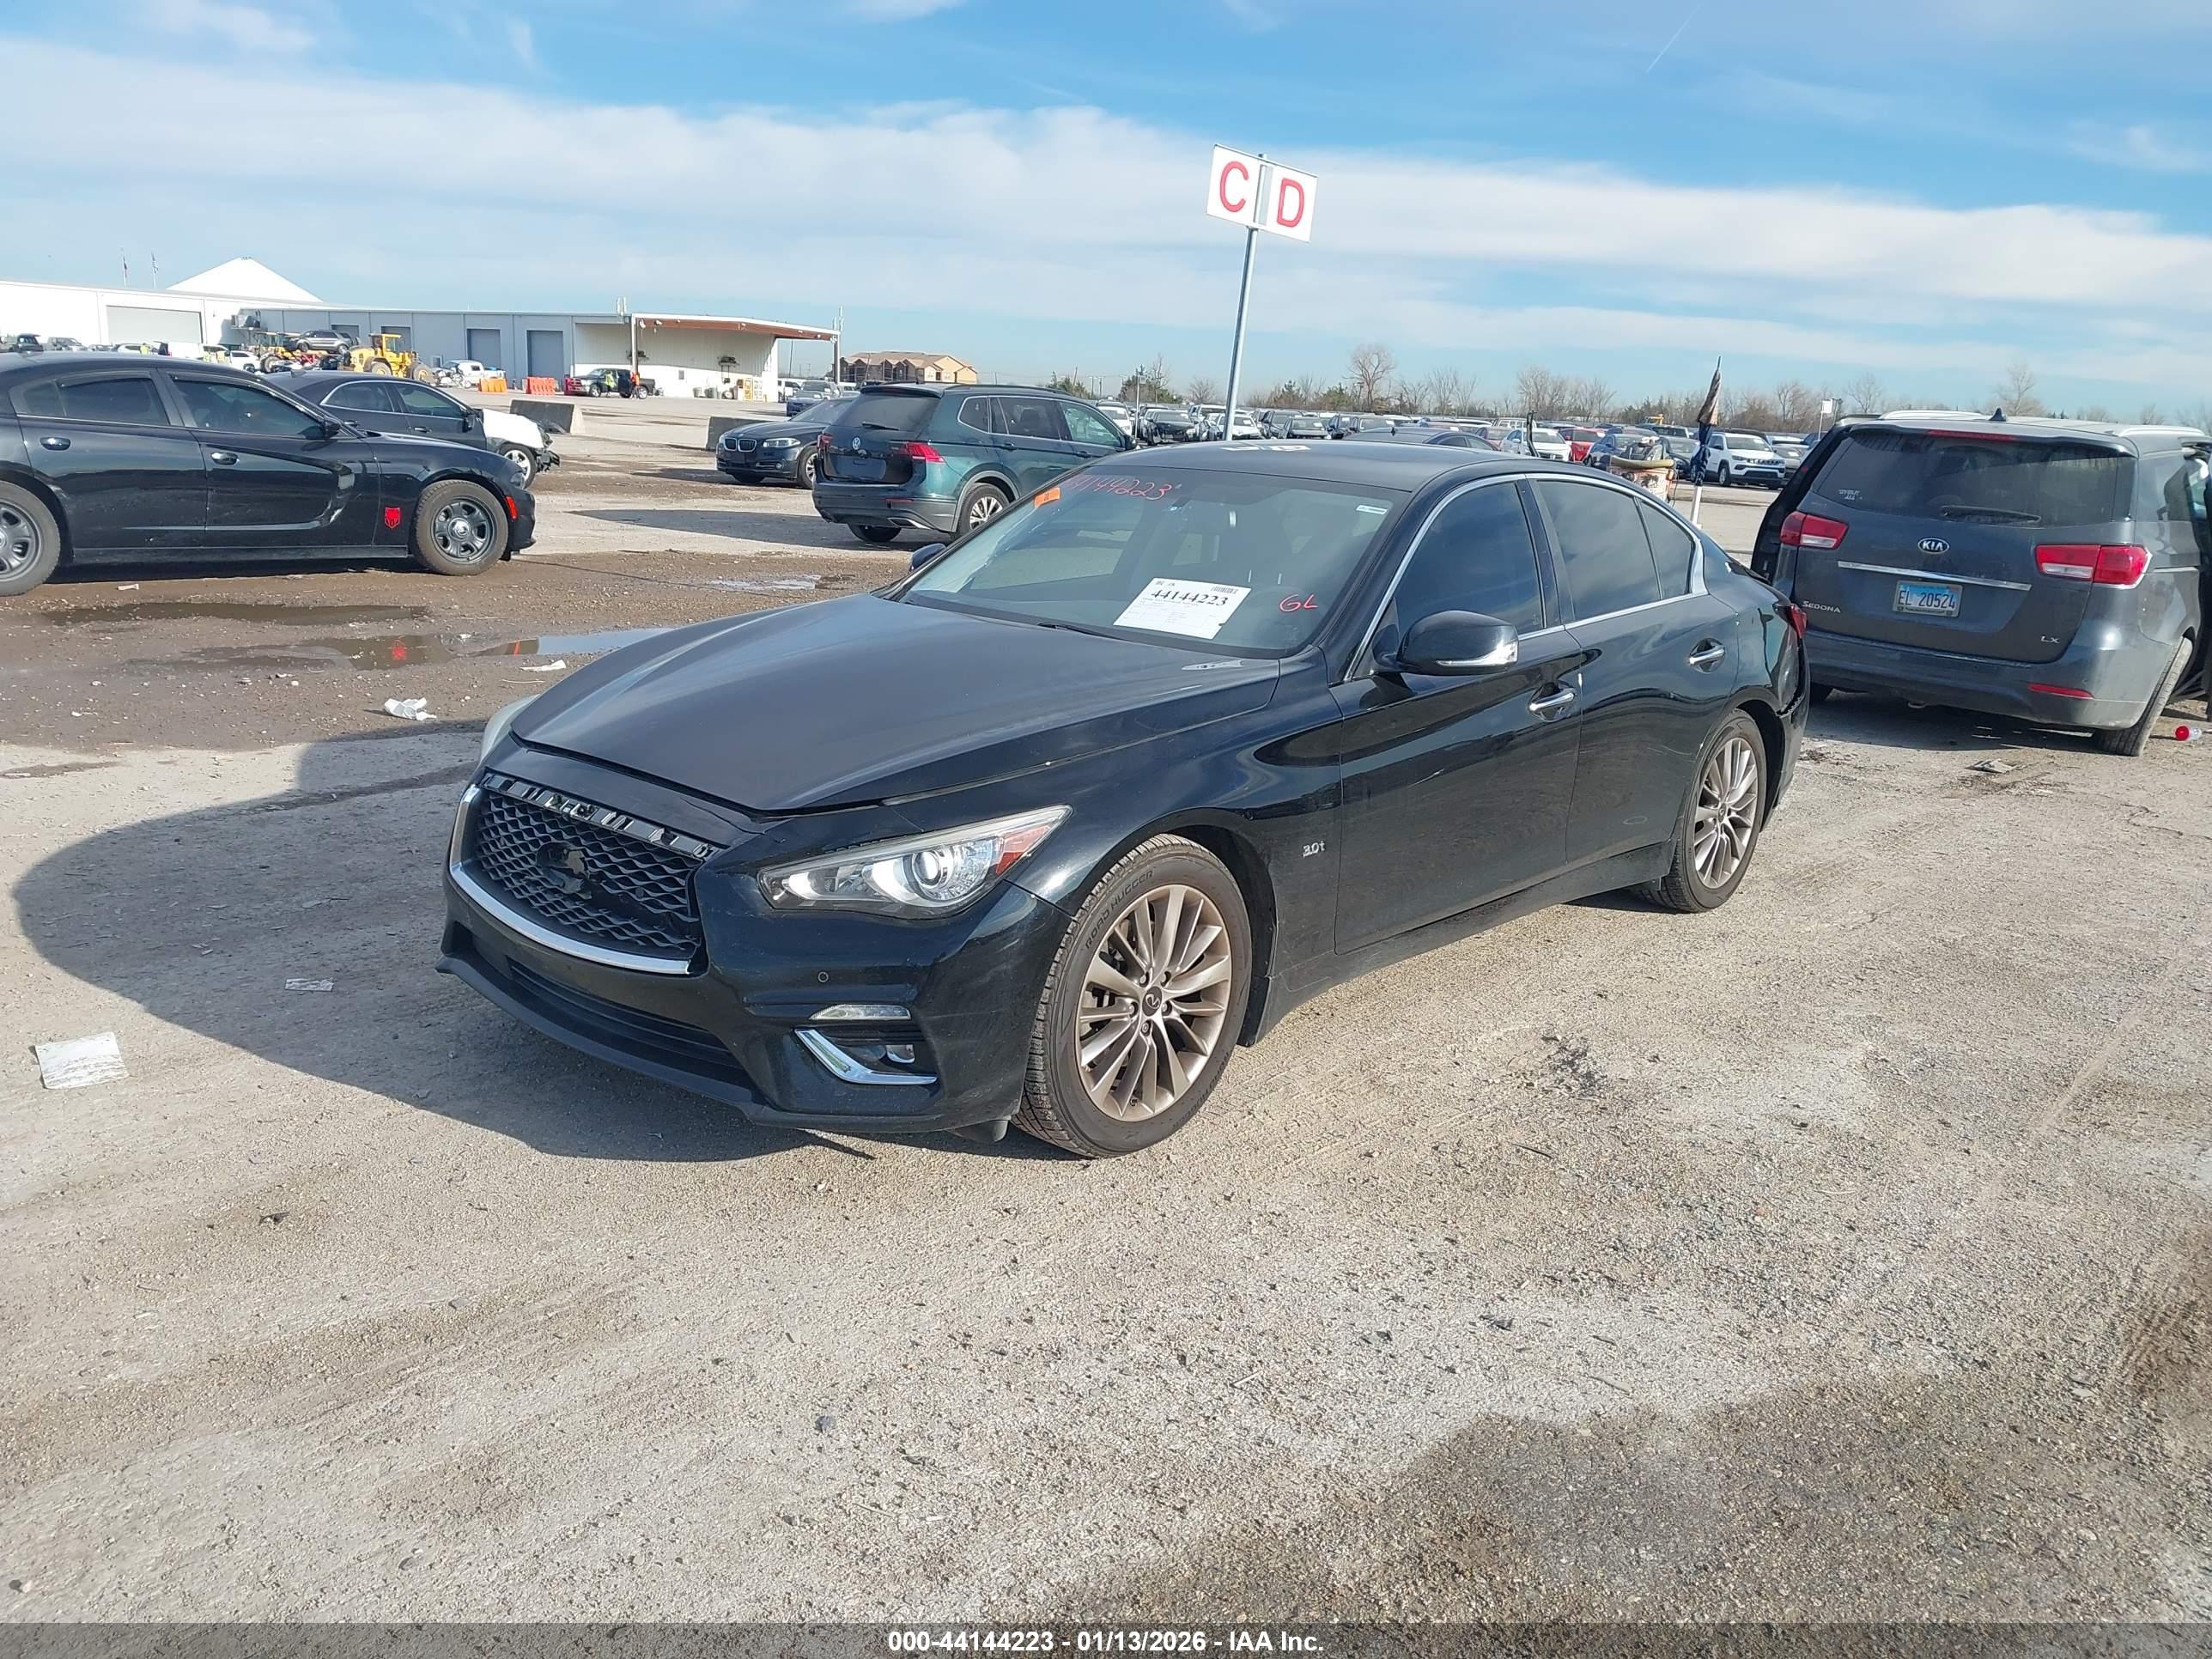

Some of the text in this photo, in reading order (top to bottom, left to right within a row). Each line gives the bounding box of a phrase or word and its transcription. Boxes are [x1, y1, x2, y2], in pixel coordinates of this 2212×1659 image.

[1220, 161, 1304, 228] C D
[1923, 540, 1944, 551] KIA
[1151, 589, 1229, 606] 44144223
[1898, 590, 1955, 609] EL 20524
[1802, 600, 1841, 613] SEDONA
[2040, 635, 2061, 644] LX
